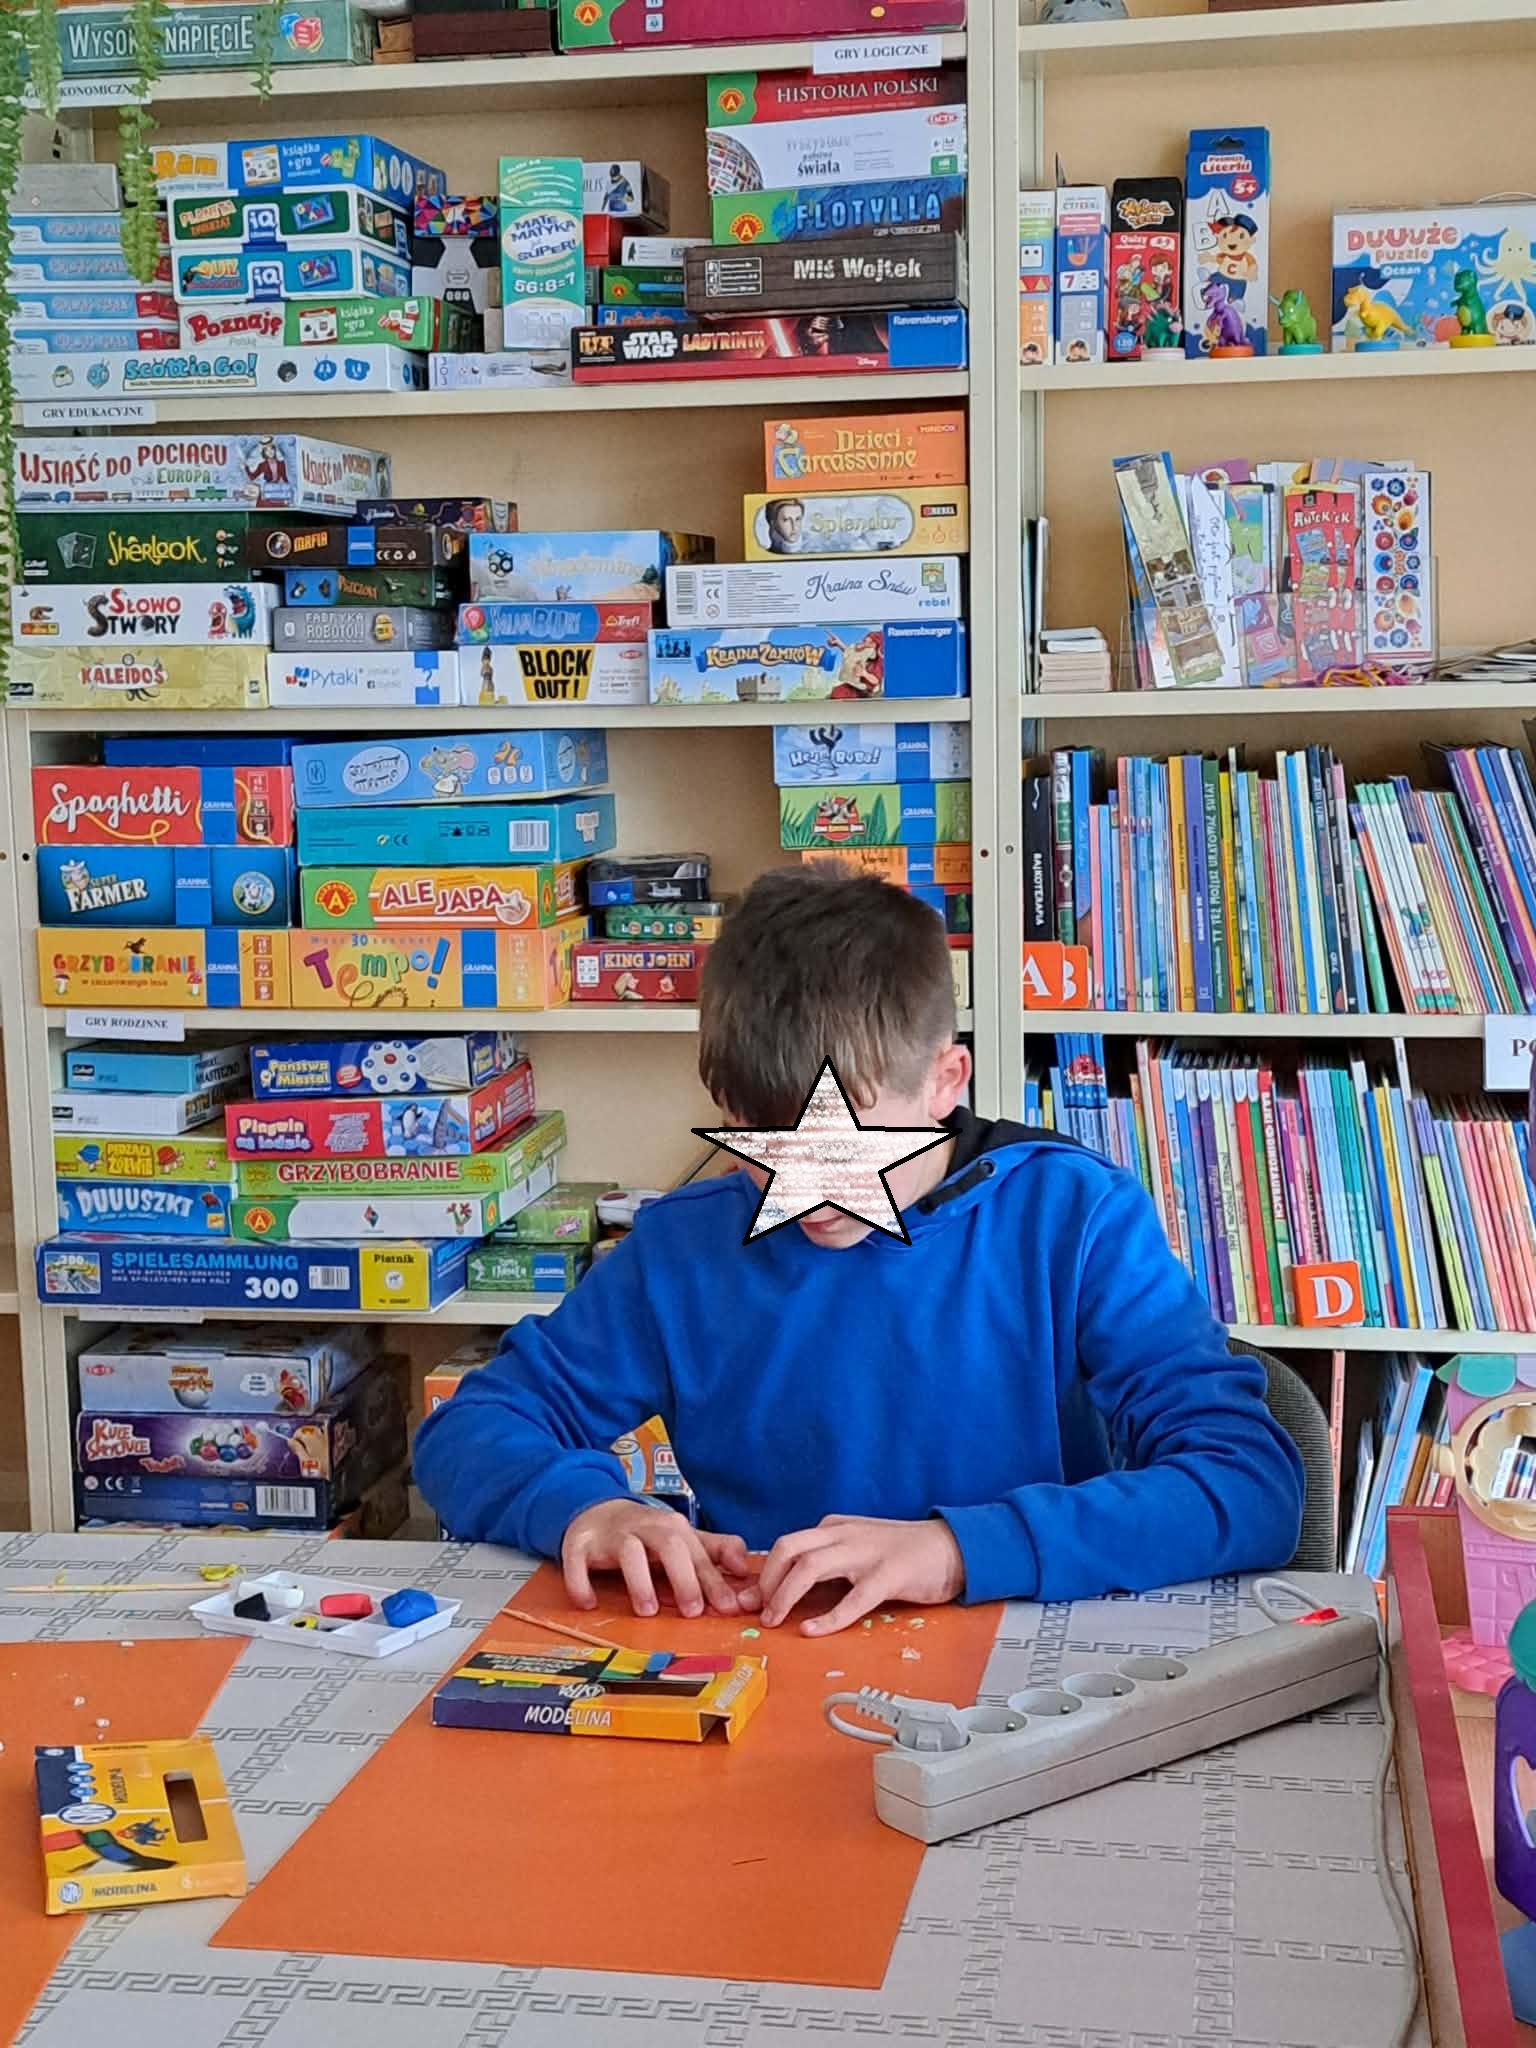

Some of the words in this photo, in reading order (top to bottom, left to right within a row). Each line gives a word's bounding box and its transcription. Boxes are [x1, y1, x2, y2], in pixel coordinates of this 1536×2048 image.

[164, 16, 253, 57] NAPIĘCIE
[834, 48, 862, 60] GRY
[863, 44, 929, 58] LOGICZNE
[61, 83, 136, 97] KONOMICZN
[777, 84, 869, 104] HISTORIA
[873, 77, 938, 97] POLSKI
[797, 155, 840, 177] świata
[1202, 163, 1251, 173] Literki
[1233, 181, 1256, 195] 5+
[796, 193, 942, 230] FLOTYLLA
[511, 219, 577, 243] MATYKA
[1120, 235, 1148, 246] Quizy
[516, 239, 577, 261] SUPER!
[793, 259, 836, 280] Miś
[842, 257, 922, 282] Wojtek
[184, 309, 284, 344] Poznaję
[893, 313, 959, 327] Ravensburger
[624, 331, 678, 347] STAR
[681, 331, 766, 352] LABYRINTH
[622, 344, 678, 360] WARS
[124, 355, 209, 380] Scottie
[213, 352, 258, 379] Go!
[42, 409, 65, 419] GRY
[67, 406, 144, 418] EDUKACYJNE
[835, 429, 902, 452] Dzieci
[105, 455, 132, 478] DO
[137, 442, 228, 470] POCIĄGU
[778, 447, 917, 478] Carcassonne
[156, 467, 212, 485] EUROPA
[809, 511, 901, 540] Splendor
[293, 531, 329, 553] MAFIA
[805, 571, 864, 603] Kraina
[109, 588, 181, 614] SŁOWO
[918, 598, 951, 608] rebel
[304, 612, 365, 623] FABRYKA
[887, 625, 952, 639] Ravensburger
[518, 649, 592, 678] BLOCK
[705, 647, 759, 668] KRAINA
[310, 668, 359, 689] Pytaki
[50, 780, 192, 833] Spaghetti
[1205, 814, 1219, 868] URATOWAĆ
[65, 877, 148, 913] FARMER
[383, 881, 435, 908] ALE
[435, 885, 503, 915] JAPA
[1033, 852, 1045, 926] BAJKOTERAPIA
[604, 952, 645, 969] KING
[647, 952, 691, 969] JOHN
[1022, 955, 1053, 997] A
[85, 1016, 107, 1027] GRY
[111, 1017, 168, 1029] RODZINNE
[238, 1116, 305, 1136] Pingwin
[278, 1160, 460, 1183] GRZYBOBRANIE
[111, 1252, 299, 1270] SPIELESAMMLUNG
[373, 1253, 415, 1265] Piatnik
[244, 1278, 299, 1299] 300
[1309, 1275, 1354, 1320] D
[524, 1705, 612, 1727] MODELINA
